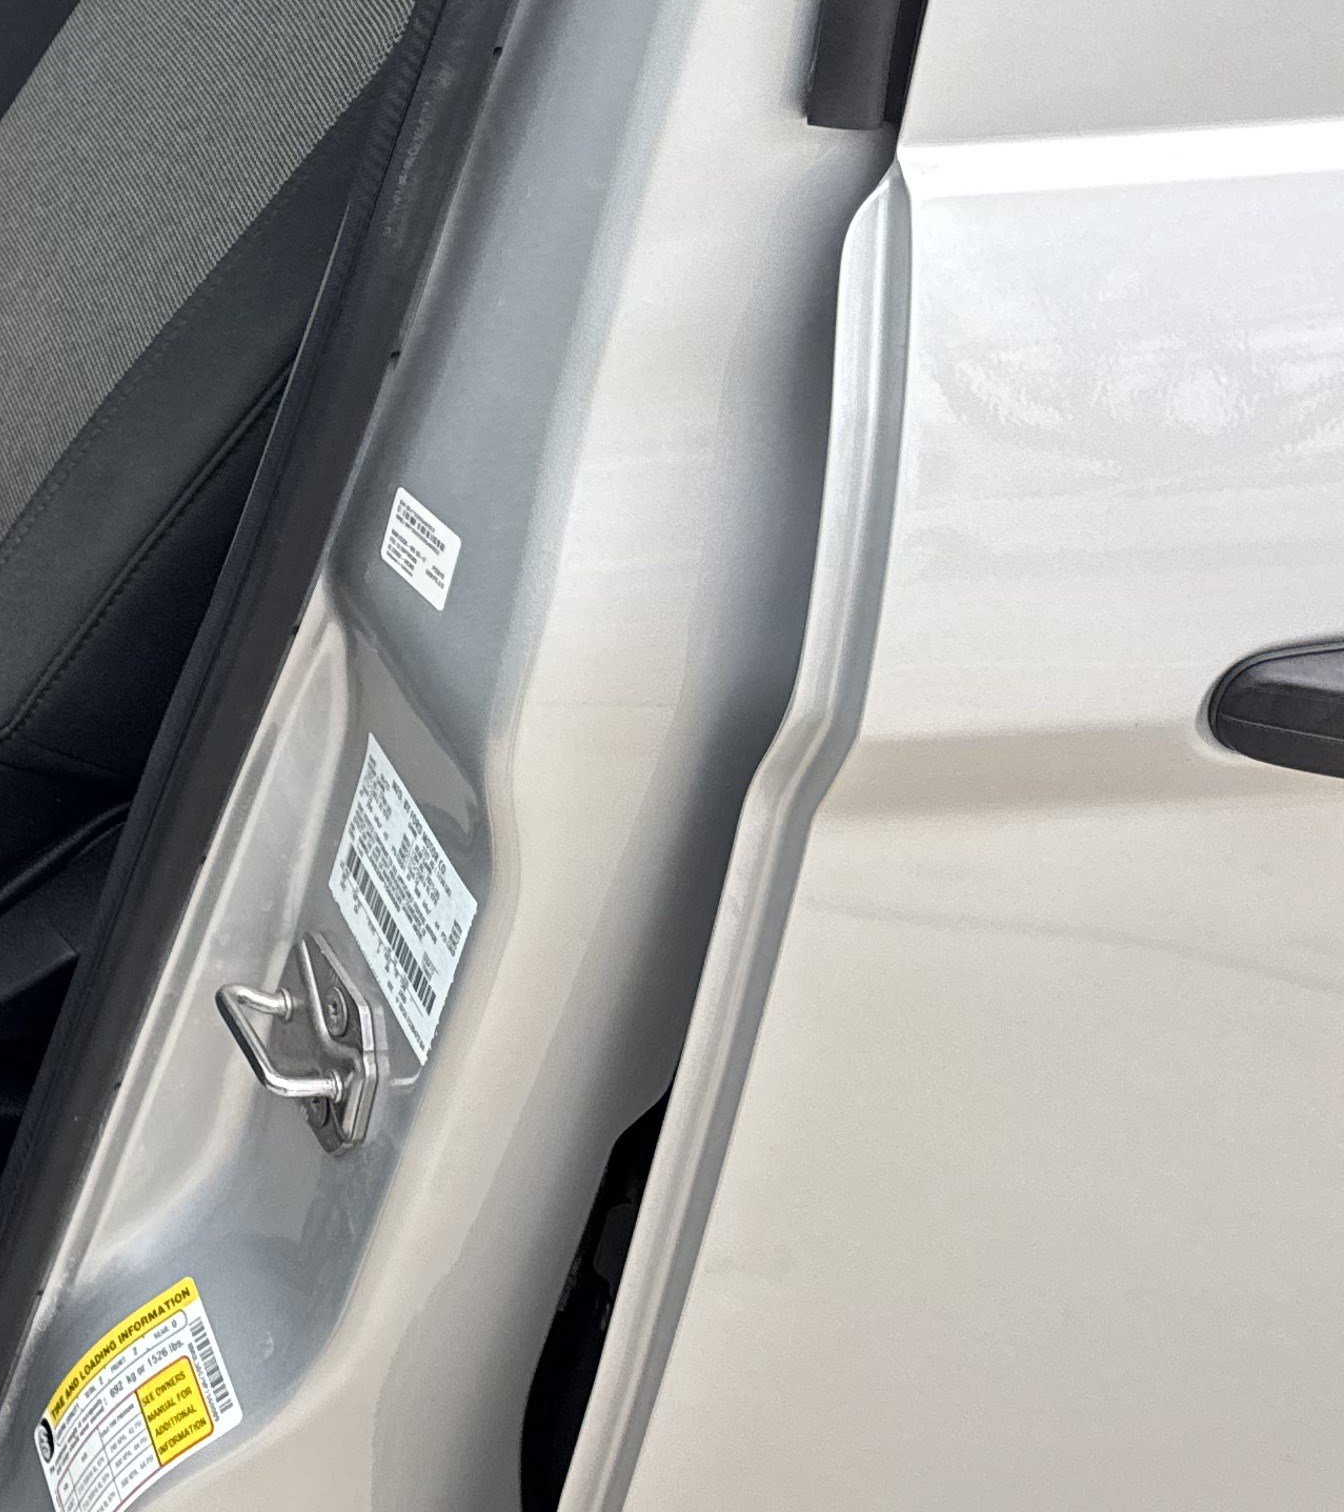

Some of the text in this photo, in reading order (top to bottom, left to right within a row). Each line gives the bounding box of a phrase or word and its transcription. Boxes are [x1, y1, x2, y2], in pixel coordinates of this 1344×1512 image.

[65, 1377, 80, 1400] AND
[79, 1339, 117, 1380] LOADING
[118, 1287, 191, 1344] INFORMATION
[141, 1371, 186, 1407] SEE OWNERS
[147, 1397, 177, 1423] MANUAL
[176, 1386, 193, 1402] FOR
[155, 1405, 197, 1437] ADDITIONAL
[159, 1417, 208, 1455] INFORMATION
